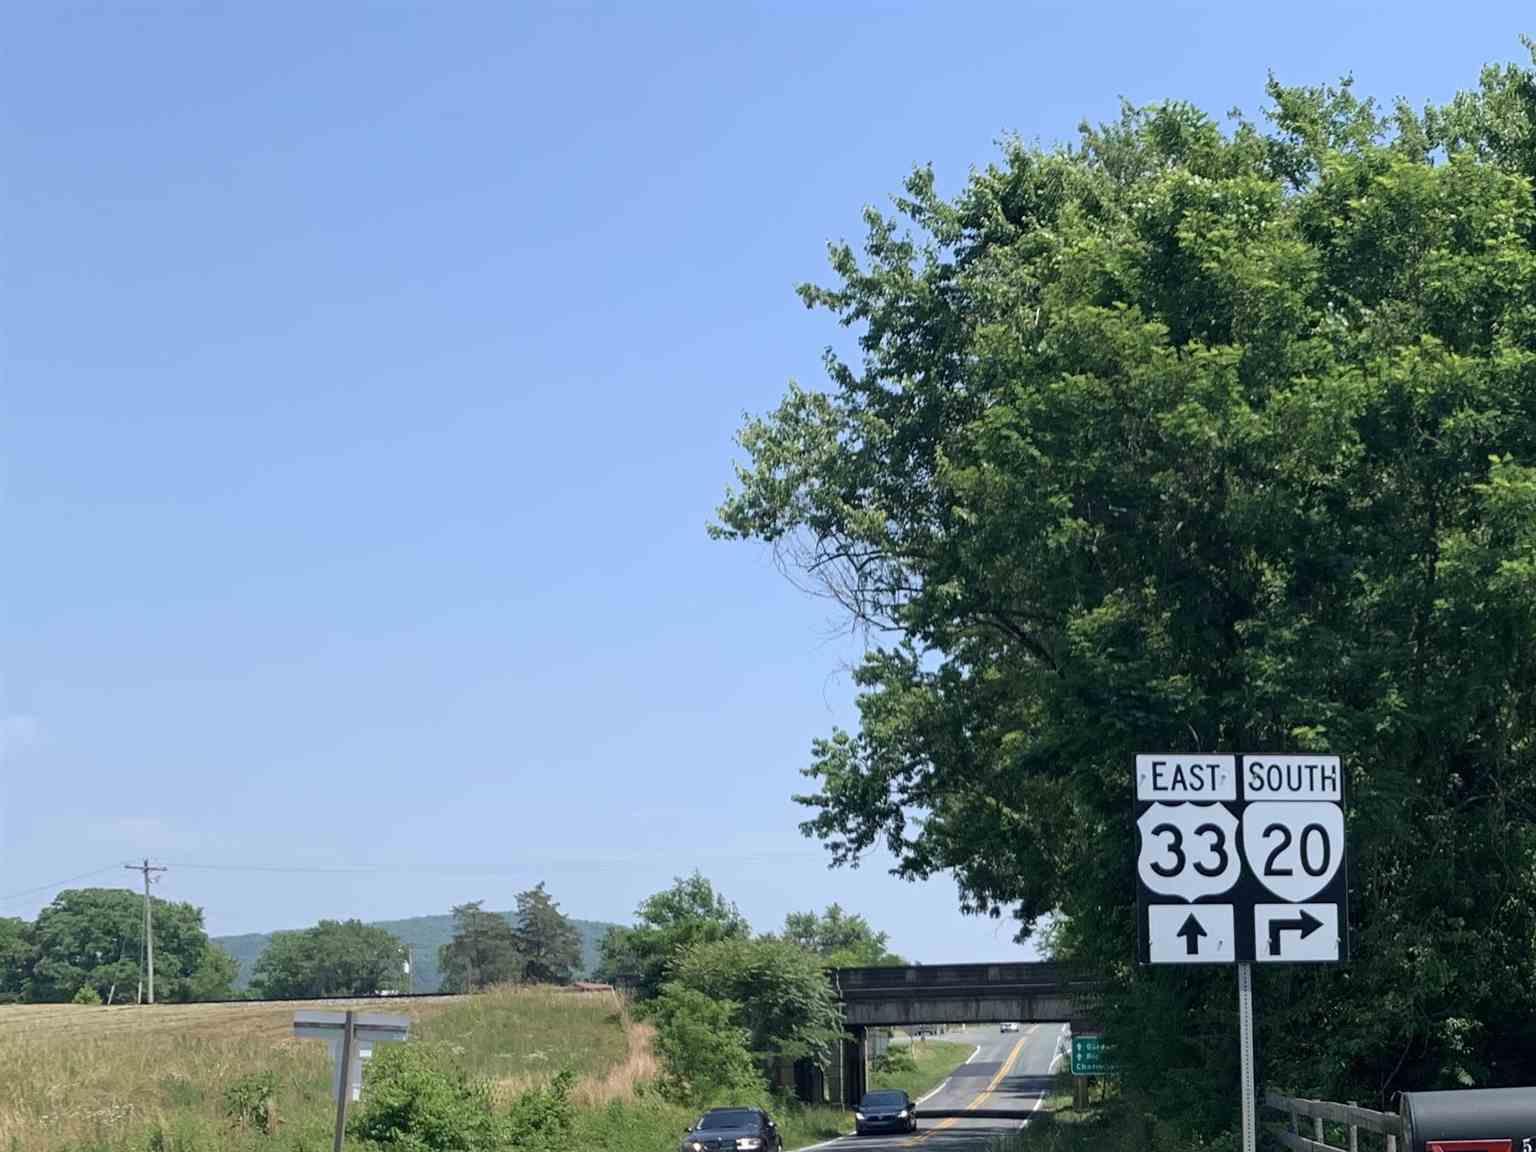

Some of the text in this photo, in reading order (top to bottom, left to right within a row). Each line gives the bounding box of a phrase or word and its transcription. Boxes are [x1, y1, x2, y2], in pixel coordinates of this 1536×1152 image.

[1151, 761, 1221, 792] EAST
[1248, 761, 1337, 792] SOUTH
[1150, 823, 1229, 878] 33
[1262, 823, 1331, 877] 20
